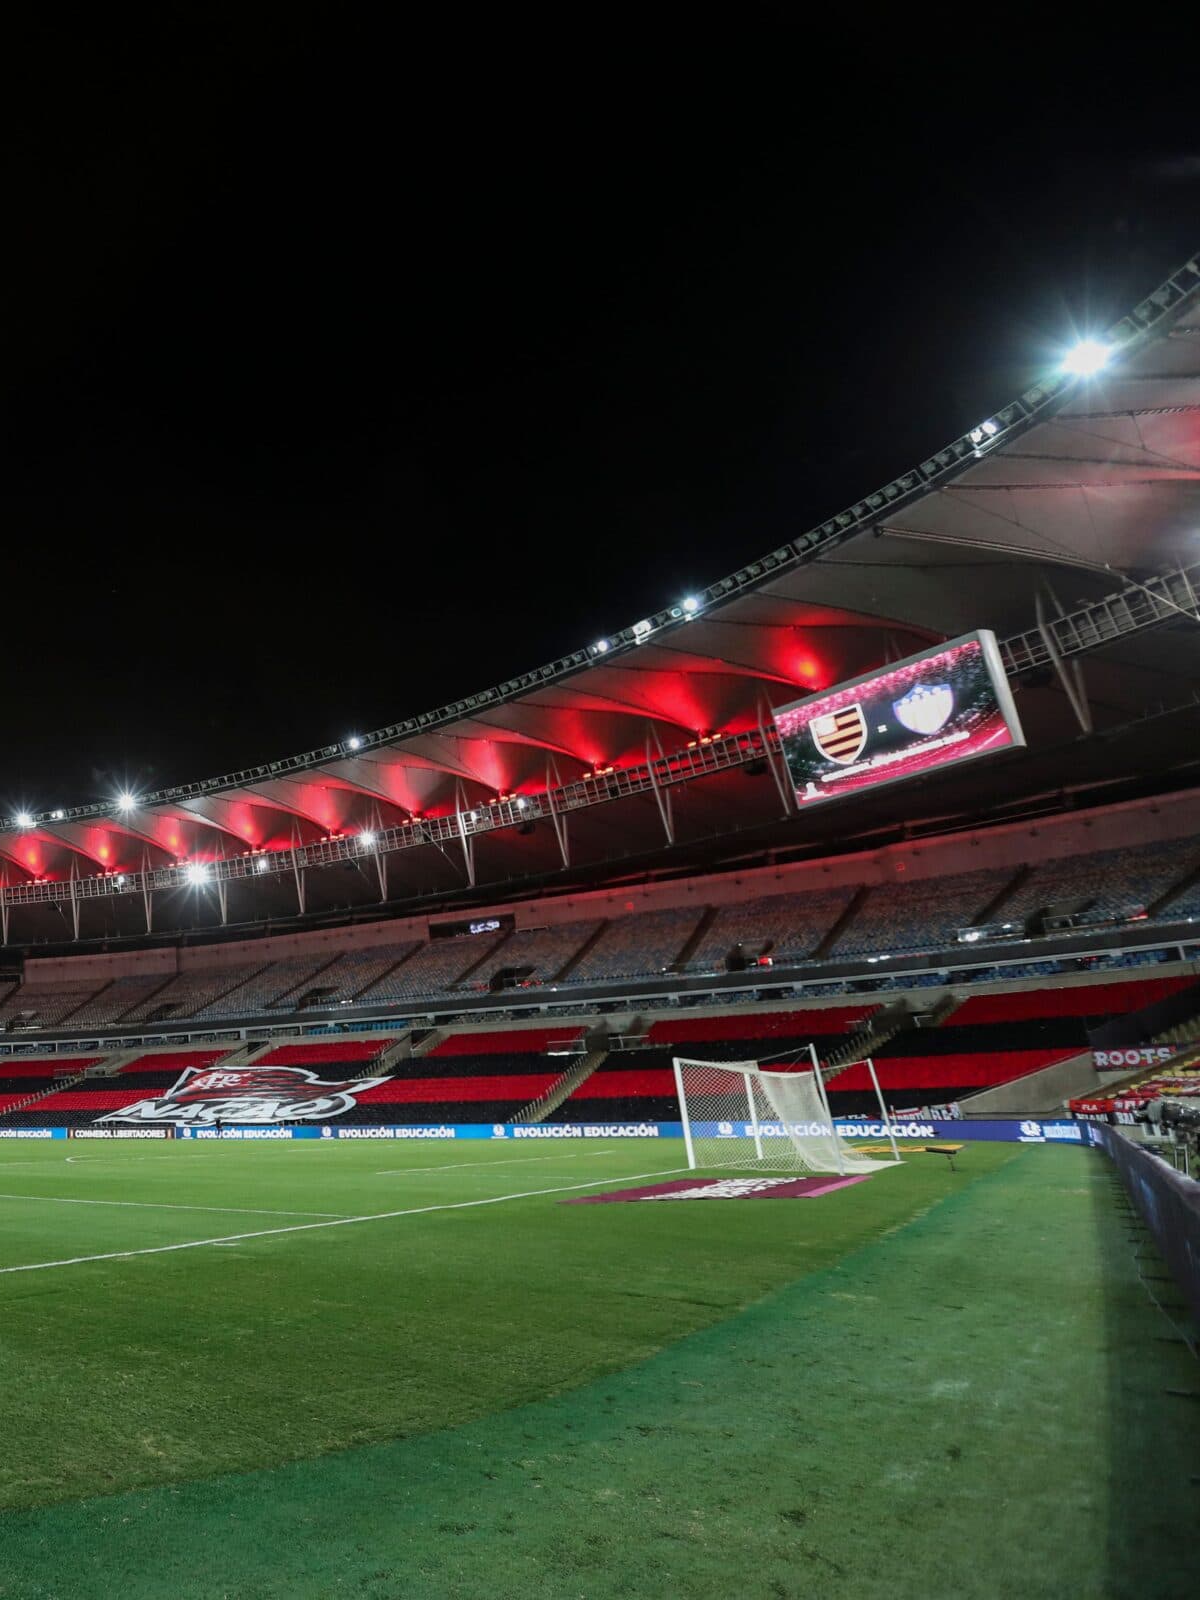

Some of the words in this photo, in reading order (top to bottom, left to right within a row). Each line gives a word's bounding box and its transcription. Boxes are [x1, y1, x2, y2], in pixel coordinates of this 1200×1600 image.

[1094, 1047, 1170, 1067] ROOTS
[243, 1128, 293, 1138] EDUCACIÓN
[338, 1127, 394, 1138] EVOLUCIÓN
[395, 1126, 455, 1138] EDUCACIÓN
[514, 1124, 582, 1138] EVOLUCIÓN
[583, 1124, 659, 1137] EDUCACIÓN
[835, 1117, 936, 1138] EDUCACIÓN
